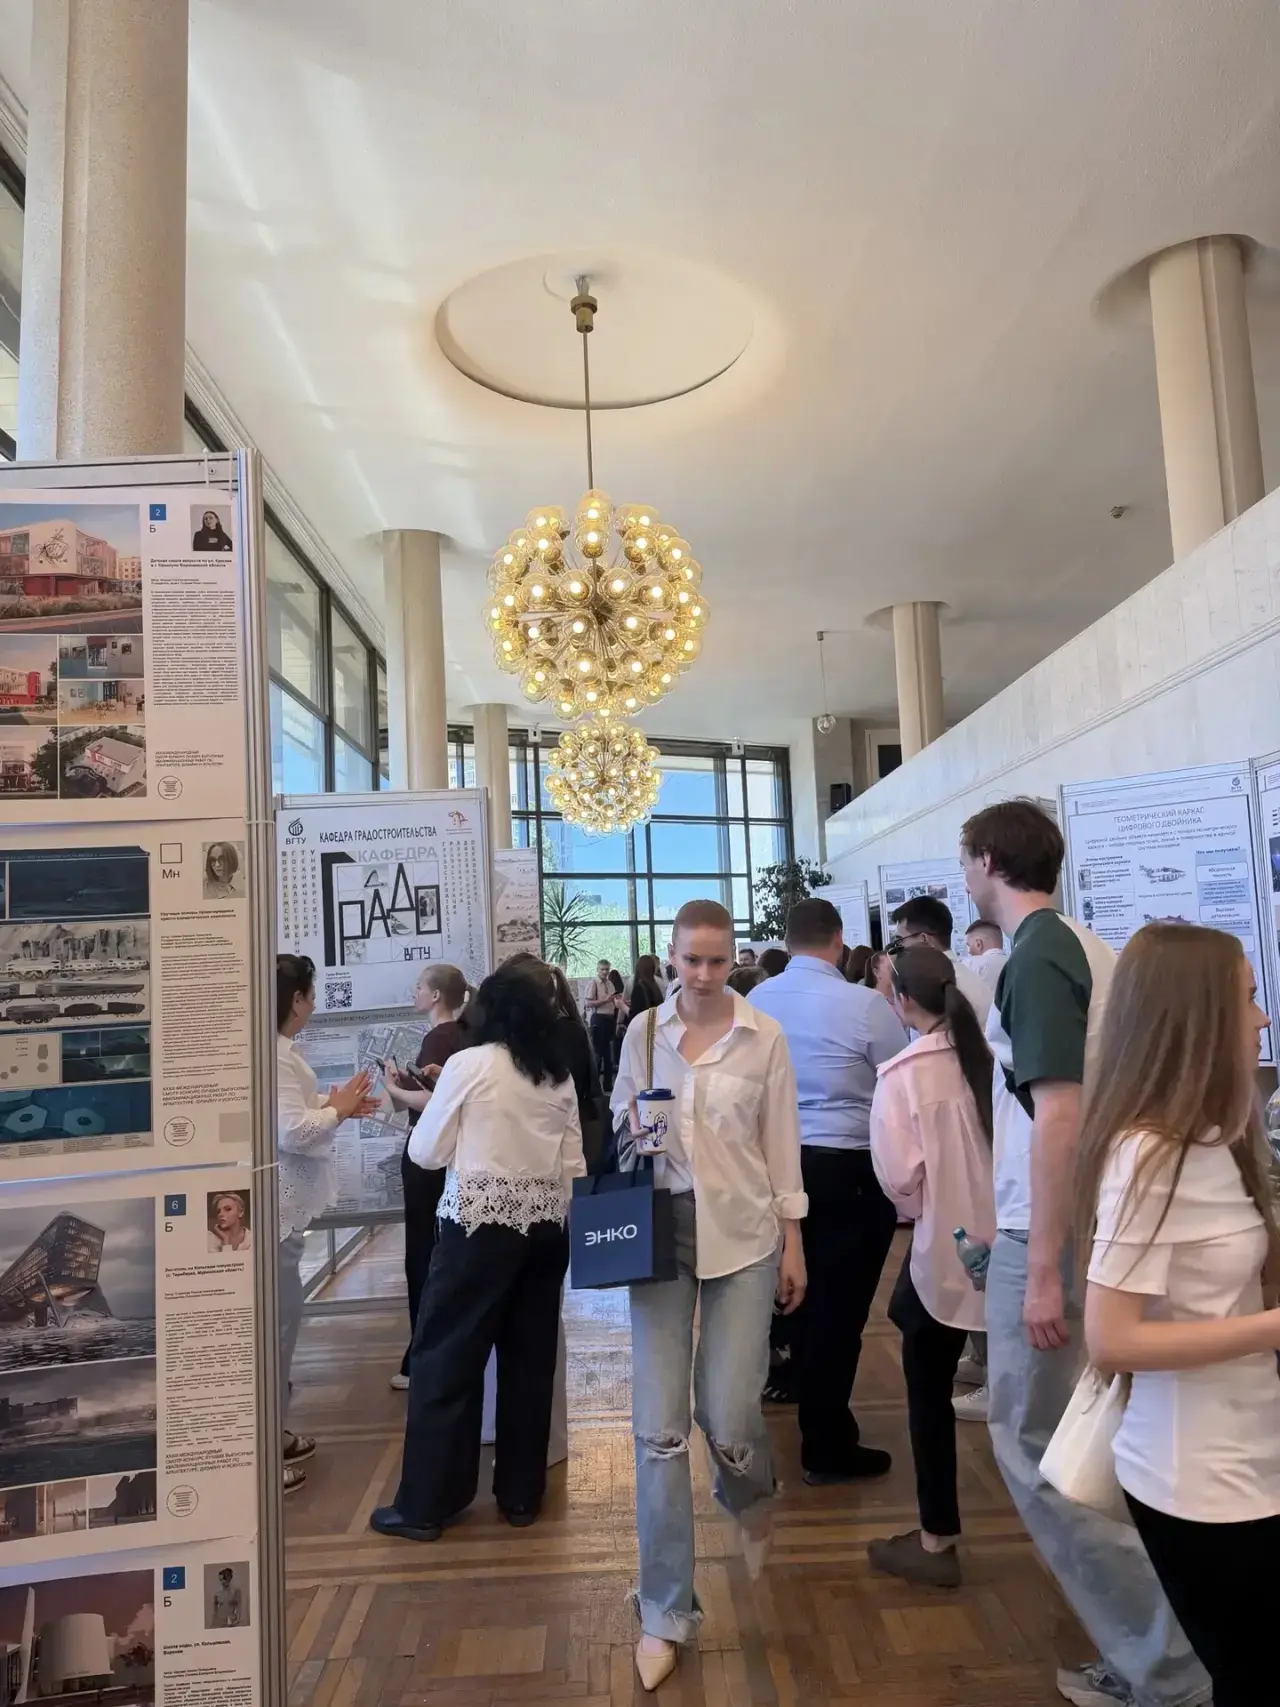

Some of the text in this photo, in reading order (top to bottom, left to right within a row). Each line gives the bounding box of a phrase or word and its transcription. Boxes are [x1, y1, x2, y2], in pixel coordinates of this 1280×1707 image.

[155, 508, 161, 517] 2
[149, 524, 157, 533] Б
[1113, 806, 1205, 823] ГЕОМЕТРИЧЕСКИЙ КАРКАС
[1117, 817, 1202, 832] ЦИФРОВОГО ДВОЙНИКА
[285, 836, 307, 845] ВГТУ
[319, 830, 353, 843] КАФЕДРА
[354, 826, 437, 841] ГРАДОСТРОИТЕЛЬСТВА
[357, 846, 438, 863] КАФЕДРА
[162, 868, 181, 879] Мн
[281, 851, 290, 939] ВОРОНЕЖСКИЙ
[301, 849, 309, 938] ТЕХНИЧЕСКИЙ
[310, 849, 318, 937] УНИВЕРСИТЕТ
[291, 850, 300, 954] ГОСУДАРСТВЕНН
[403, 946, 431, 961] ВГТУ
[171, 1200, 179, 1210] 6
[165, 1221, 174, 1232] Б
[584, 1224, 638, 1246] ЭНКО
[170, 1573, 178, 1584] 2
[163, 1595, 173, 1608] Б
